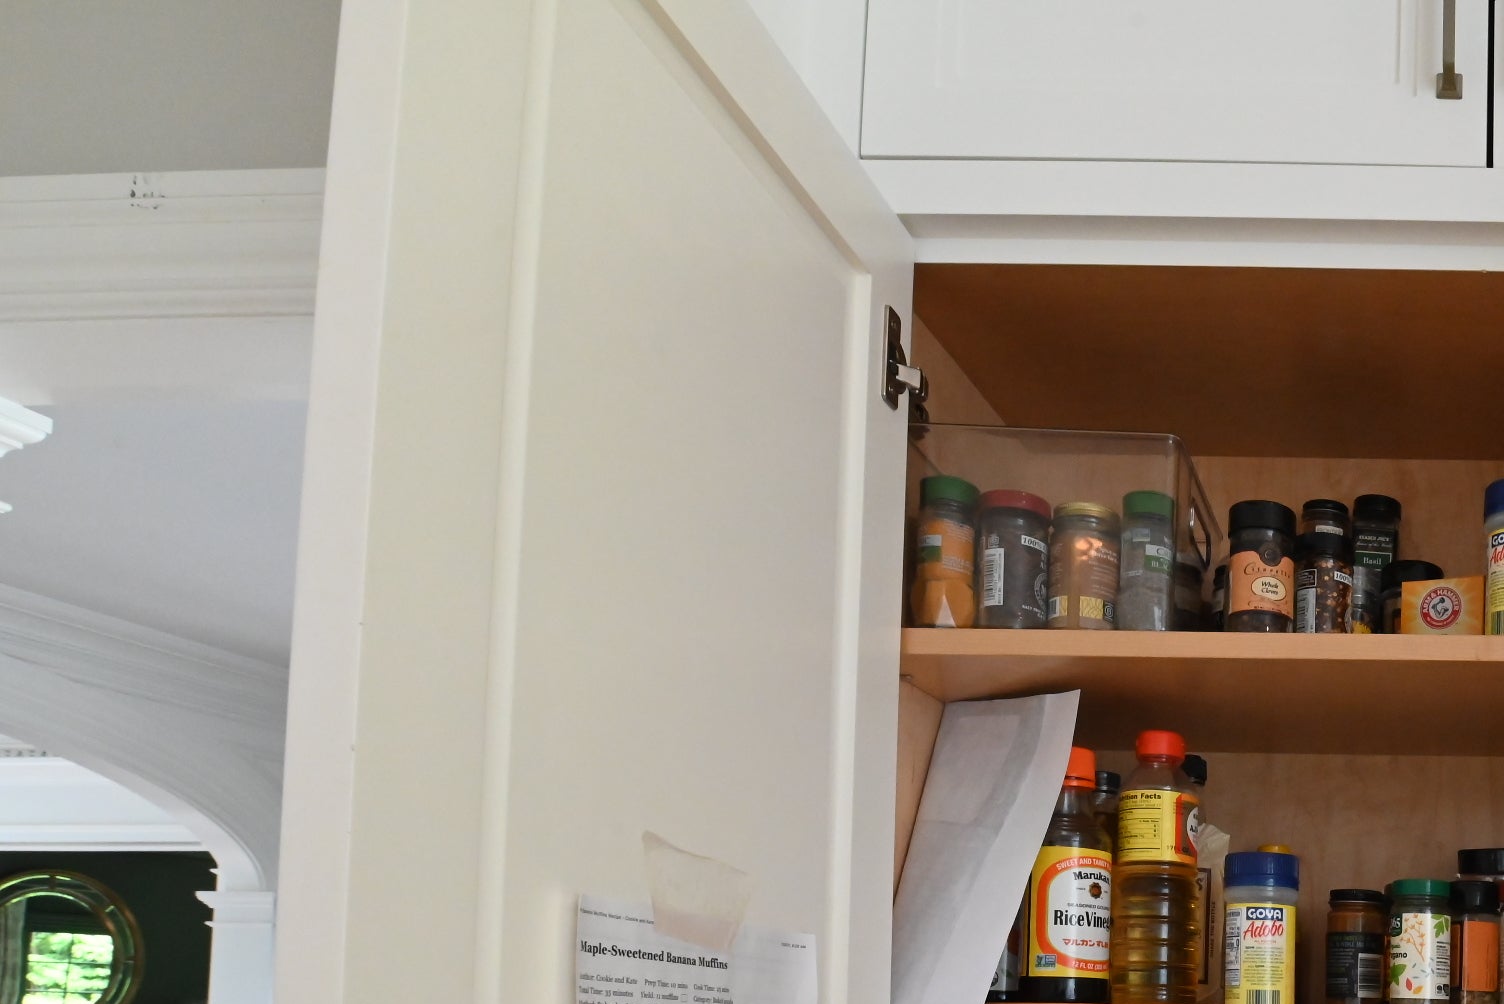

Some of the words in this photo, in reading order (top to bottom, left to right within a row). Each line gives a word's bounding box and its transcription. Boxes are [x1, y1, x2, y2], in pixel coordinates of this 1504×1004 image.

[1363, 557, 1382, 566] Basil
[1056, 857, 1079, 871] SWEET
[1079, 857, 1092, 865] AND
[1073, 870, 1110, 885] Marukan
[1053, 909, 1085, 927] Rice
[1247, 908, 1282, 920] GOYA
[1243, 919, 1284, 940] Adobo
[580, 940, 665, 962] Maple-Sweetened
[666, 952, 697, 966] Banana
[698, 956, 728, 970] Muffins
[596, 974, 614, 983] Cookie
[625, 977, 638, 985] Kate
[644, 979, 656, 988] Prep
